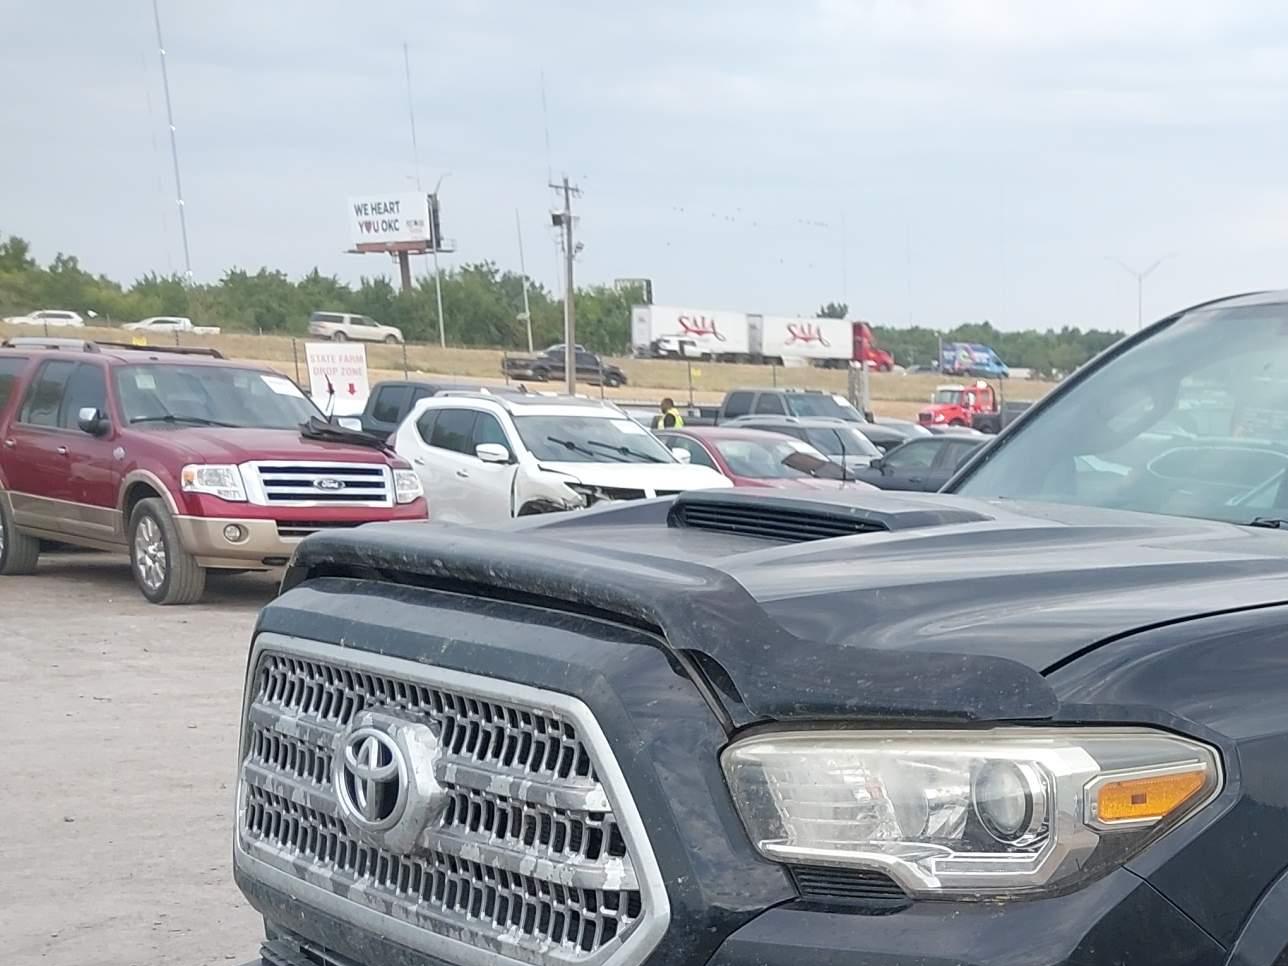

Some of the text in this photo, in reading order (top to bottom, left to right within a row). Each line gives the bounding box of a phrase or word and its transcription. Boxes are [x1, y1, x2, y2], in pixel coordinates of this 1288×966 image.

[354, 201, 400, 217] WE HEART
[381, 219, 400, 232] OKC
[311, 353, 364, 363] STATE FARM
[313, 367, 362, 377] DROP ZONE
